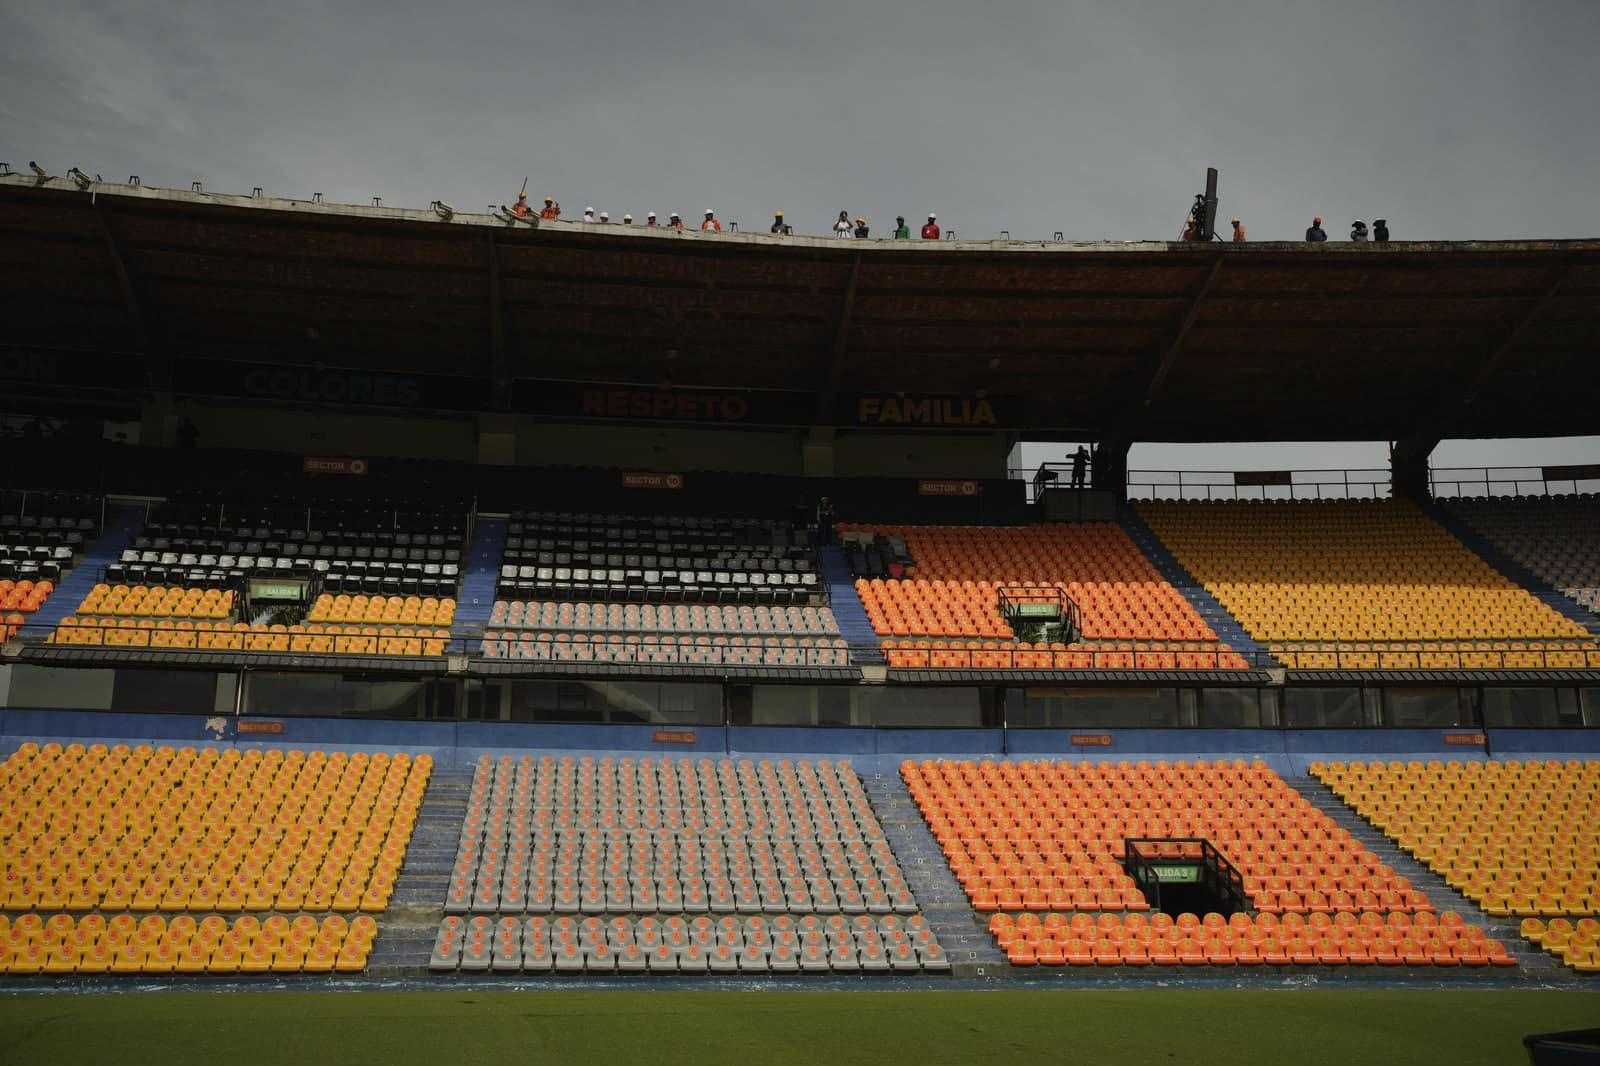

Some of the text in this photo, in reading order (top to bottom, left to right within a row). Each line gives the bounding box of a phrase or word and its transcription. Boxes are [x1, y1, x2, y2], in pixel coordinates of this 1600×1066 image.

[244, 369, 418, 401] COLORES
[583, 389, 749, 421] RESPETO
[859, 398, 998, 425] FAMILIA
[305, 460, 345, 471] SECTOR
[625, 476, 663, 486] SECTOR
[922, 483, 958, 492] SECTOR
